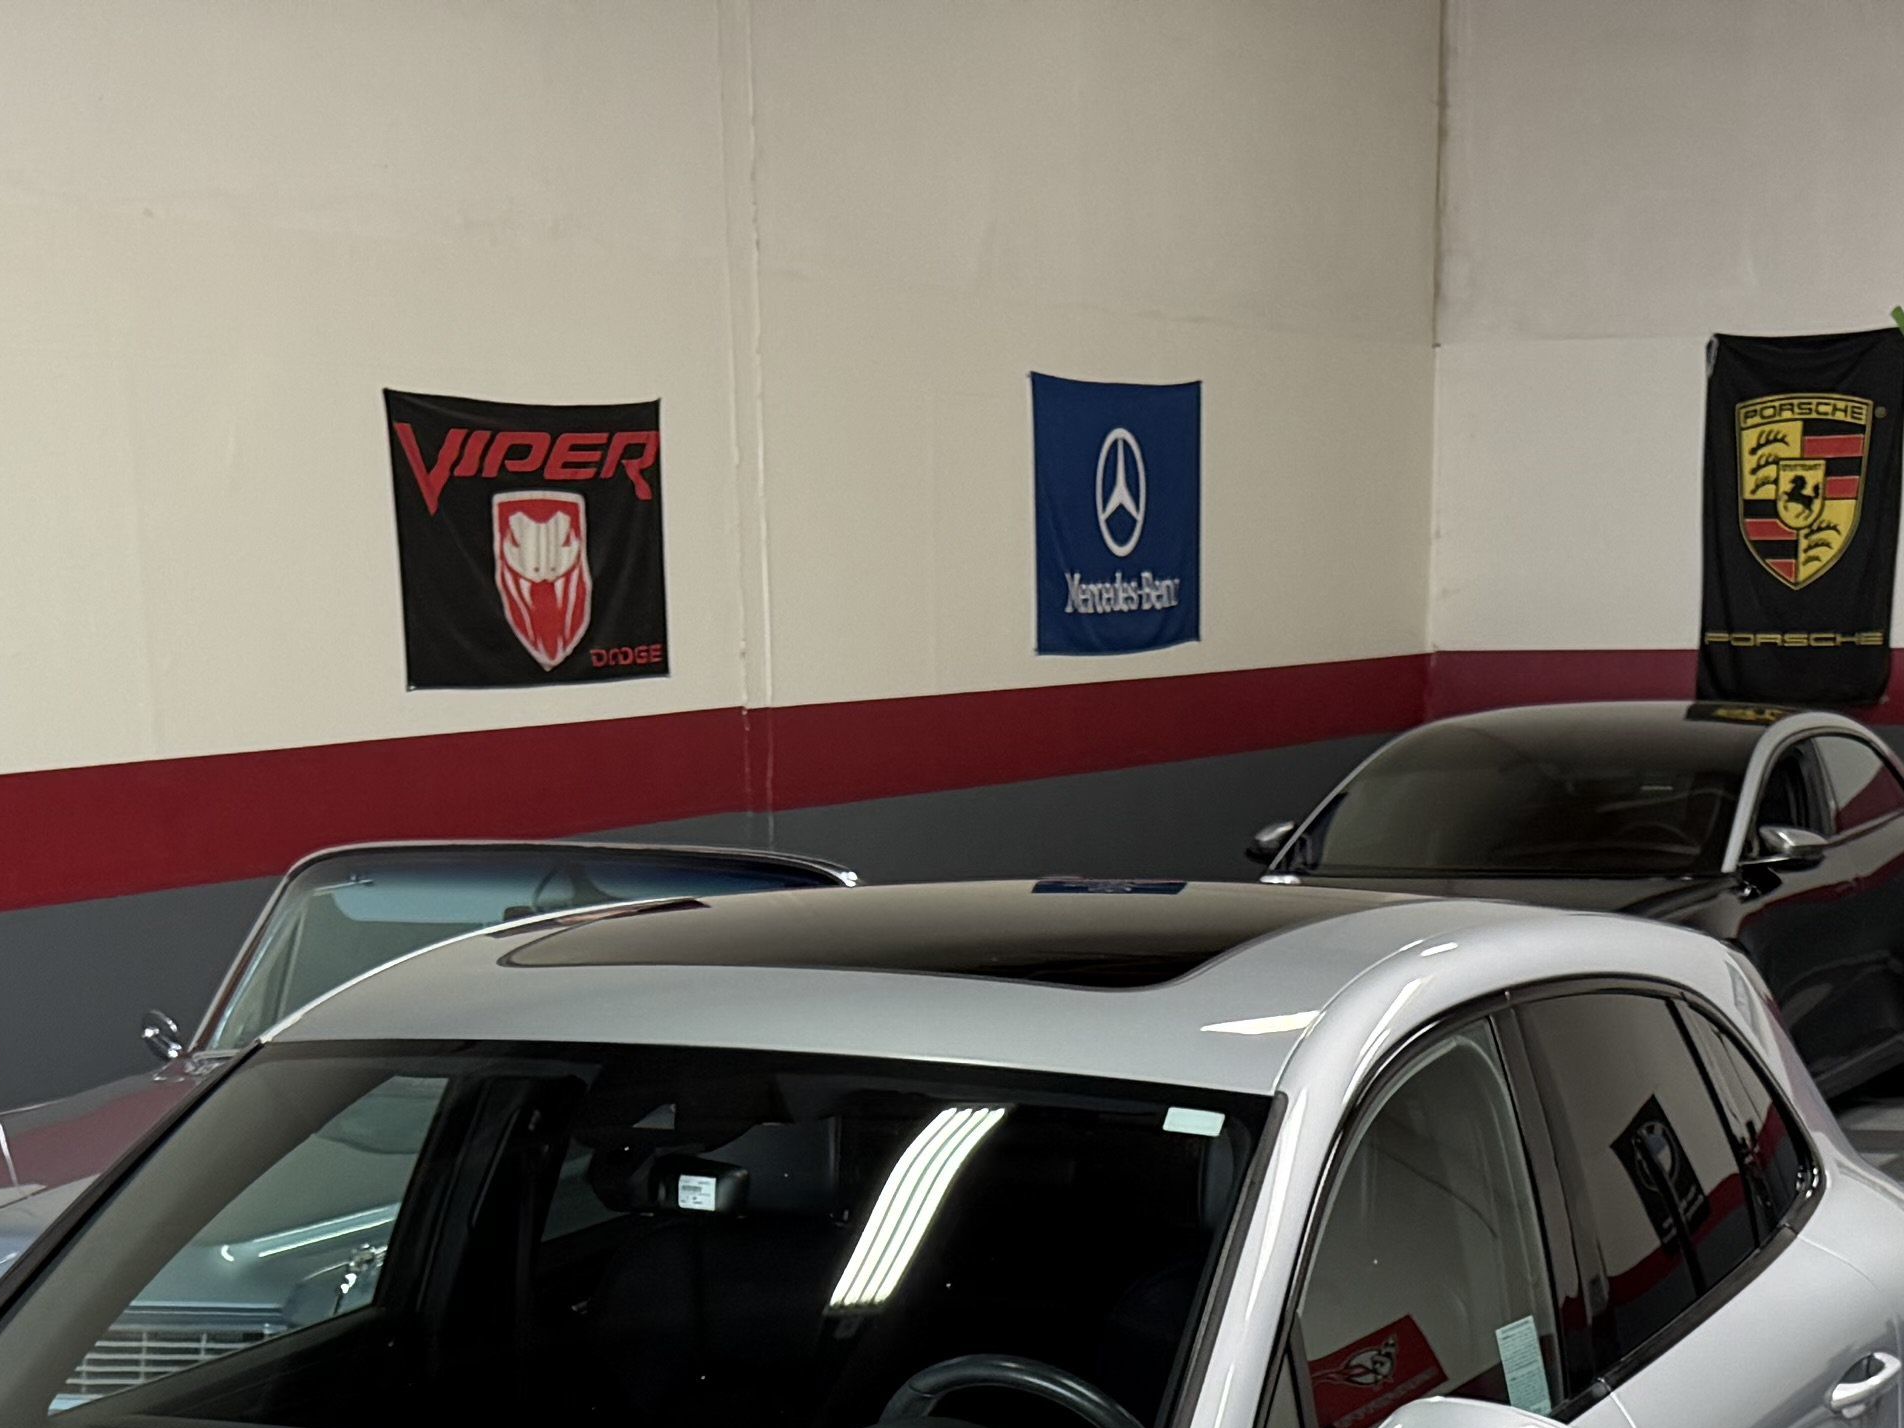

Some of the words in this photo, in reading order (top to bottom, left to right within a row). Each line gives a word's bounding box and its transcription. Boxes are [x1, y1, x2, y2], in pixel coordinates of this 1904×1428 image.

[1743, 401, 1864, 424] PORSCHE
[393, 422, 660, 517] VIPER
[1704, 632, 1884, 647] PORSCHE
[590, 644, 663, 668] DODGE
